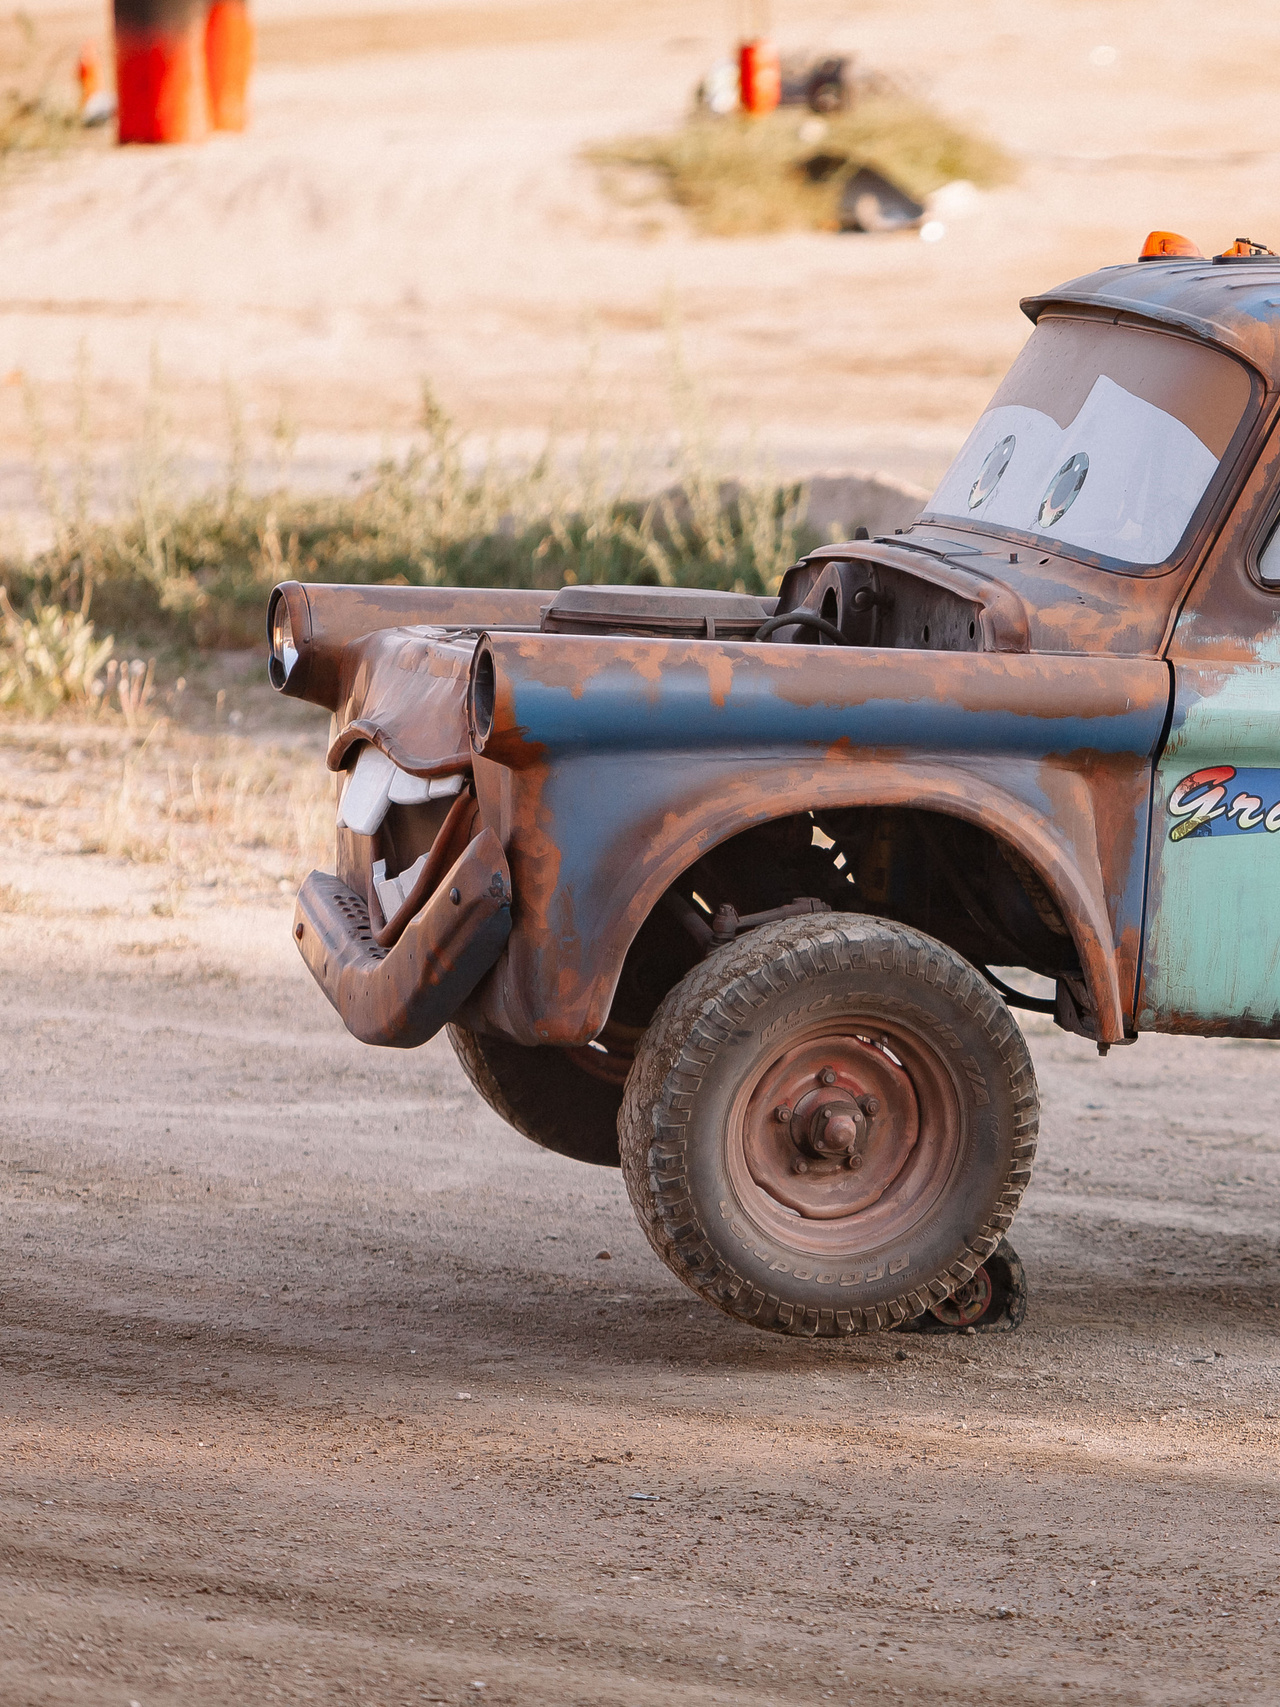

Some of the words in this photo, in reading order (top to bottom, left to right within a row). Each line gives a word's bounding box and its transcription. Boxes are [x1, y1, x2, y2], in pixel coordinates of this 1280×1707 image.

[759, 991, 964, 1049] Mud-Terrain
[961, 1055, 991, 1106] T/A
[718, 1200, 909, 1287] BFGoodrich
